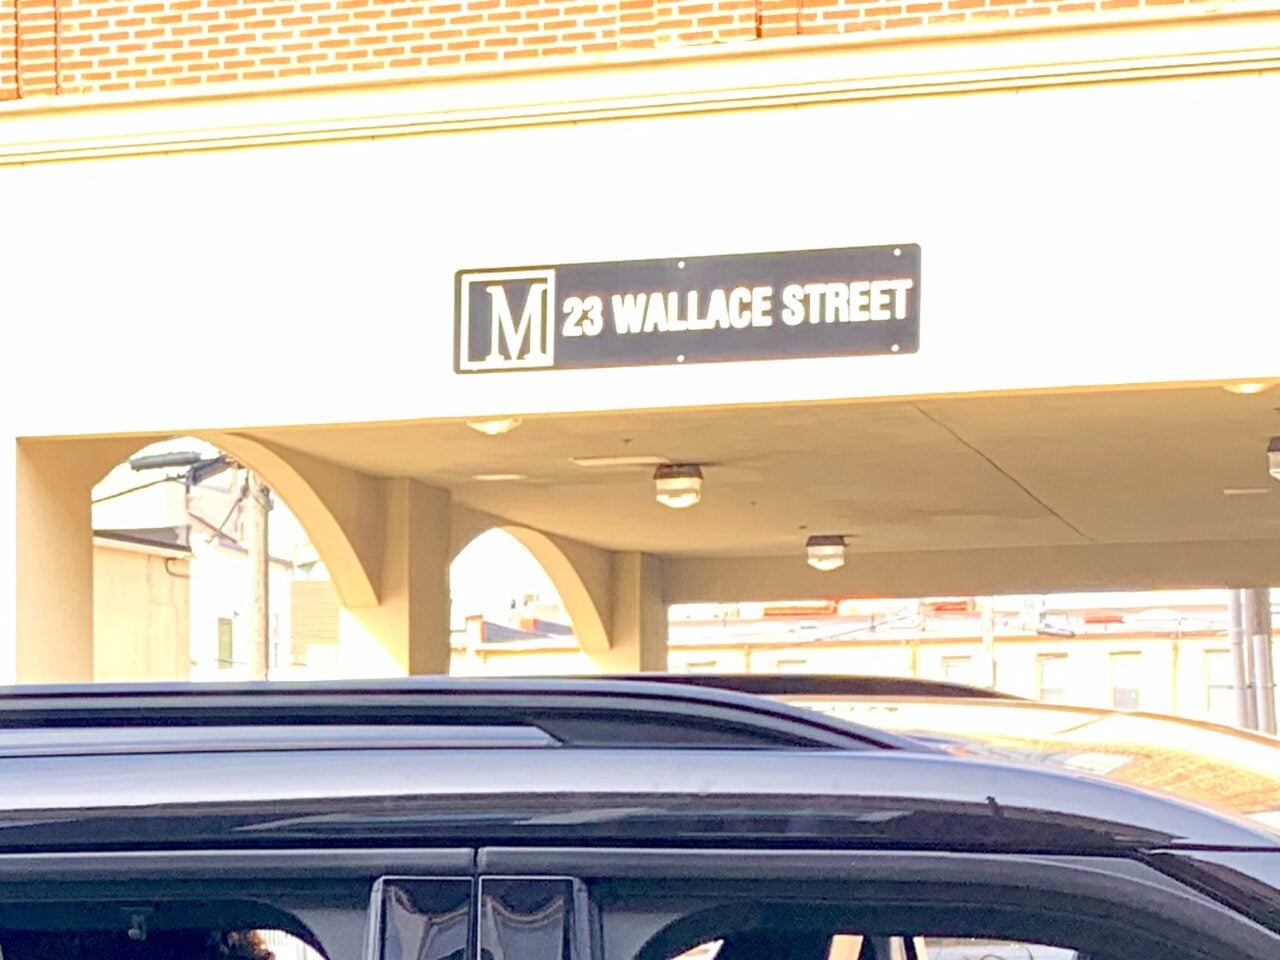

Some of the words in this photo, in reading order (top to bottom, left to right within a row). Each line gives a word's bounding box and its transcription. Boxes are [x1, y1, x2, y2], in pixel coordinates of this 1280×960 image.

[486, 283, 548, 361] M
[562, 297, 604, 336] 23
[612, 286, 773, 334] WALLACE
[782, 279, 914, 326] STREET
